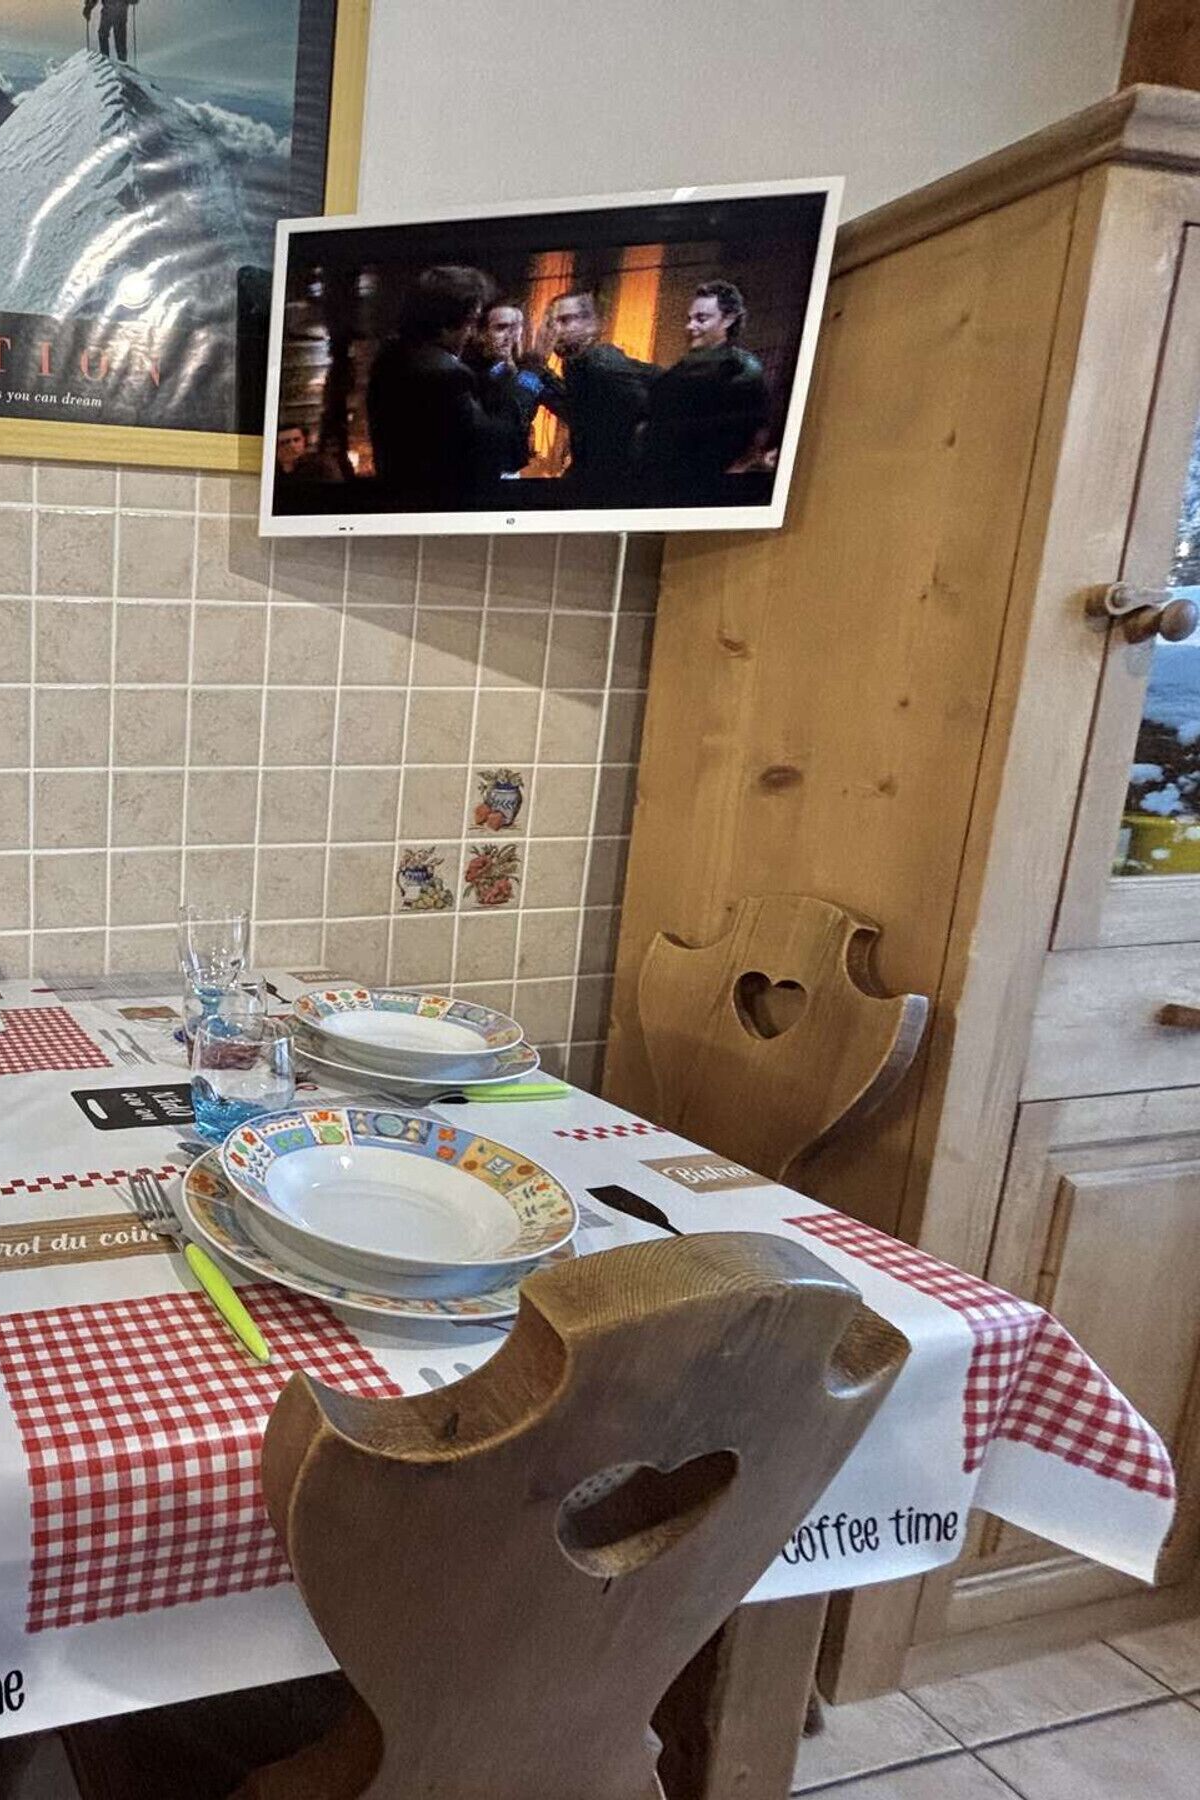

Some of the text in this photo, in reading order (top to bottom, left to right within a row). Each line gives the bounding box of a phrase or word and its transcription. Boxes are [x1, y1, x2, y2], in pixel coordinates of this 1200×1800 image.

[6, 390, 31, 404] you
[34, 394, 58, 404] can
[61, 392, 104, 408] dream
[51, 1233, 87, 1250] du
[888, 1506, 959, 1546] time
